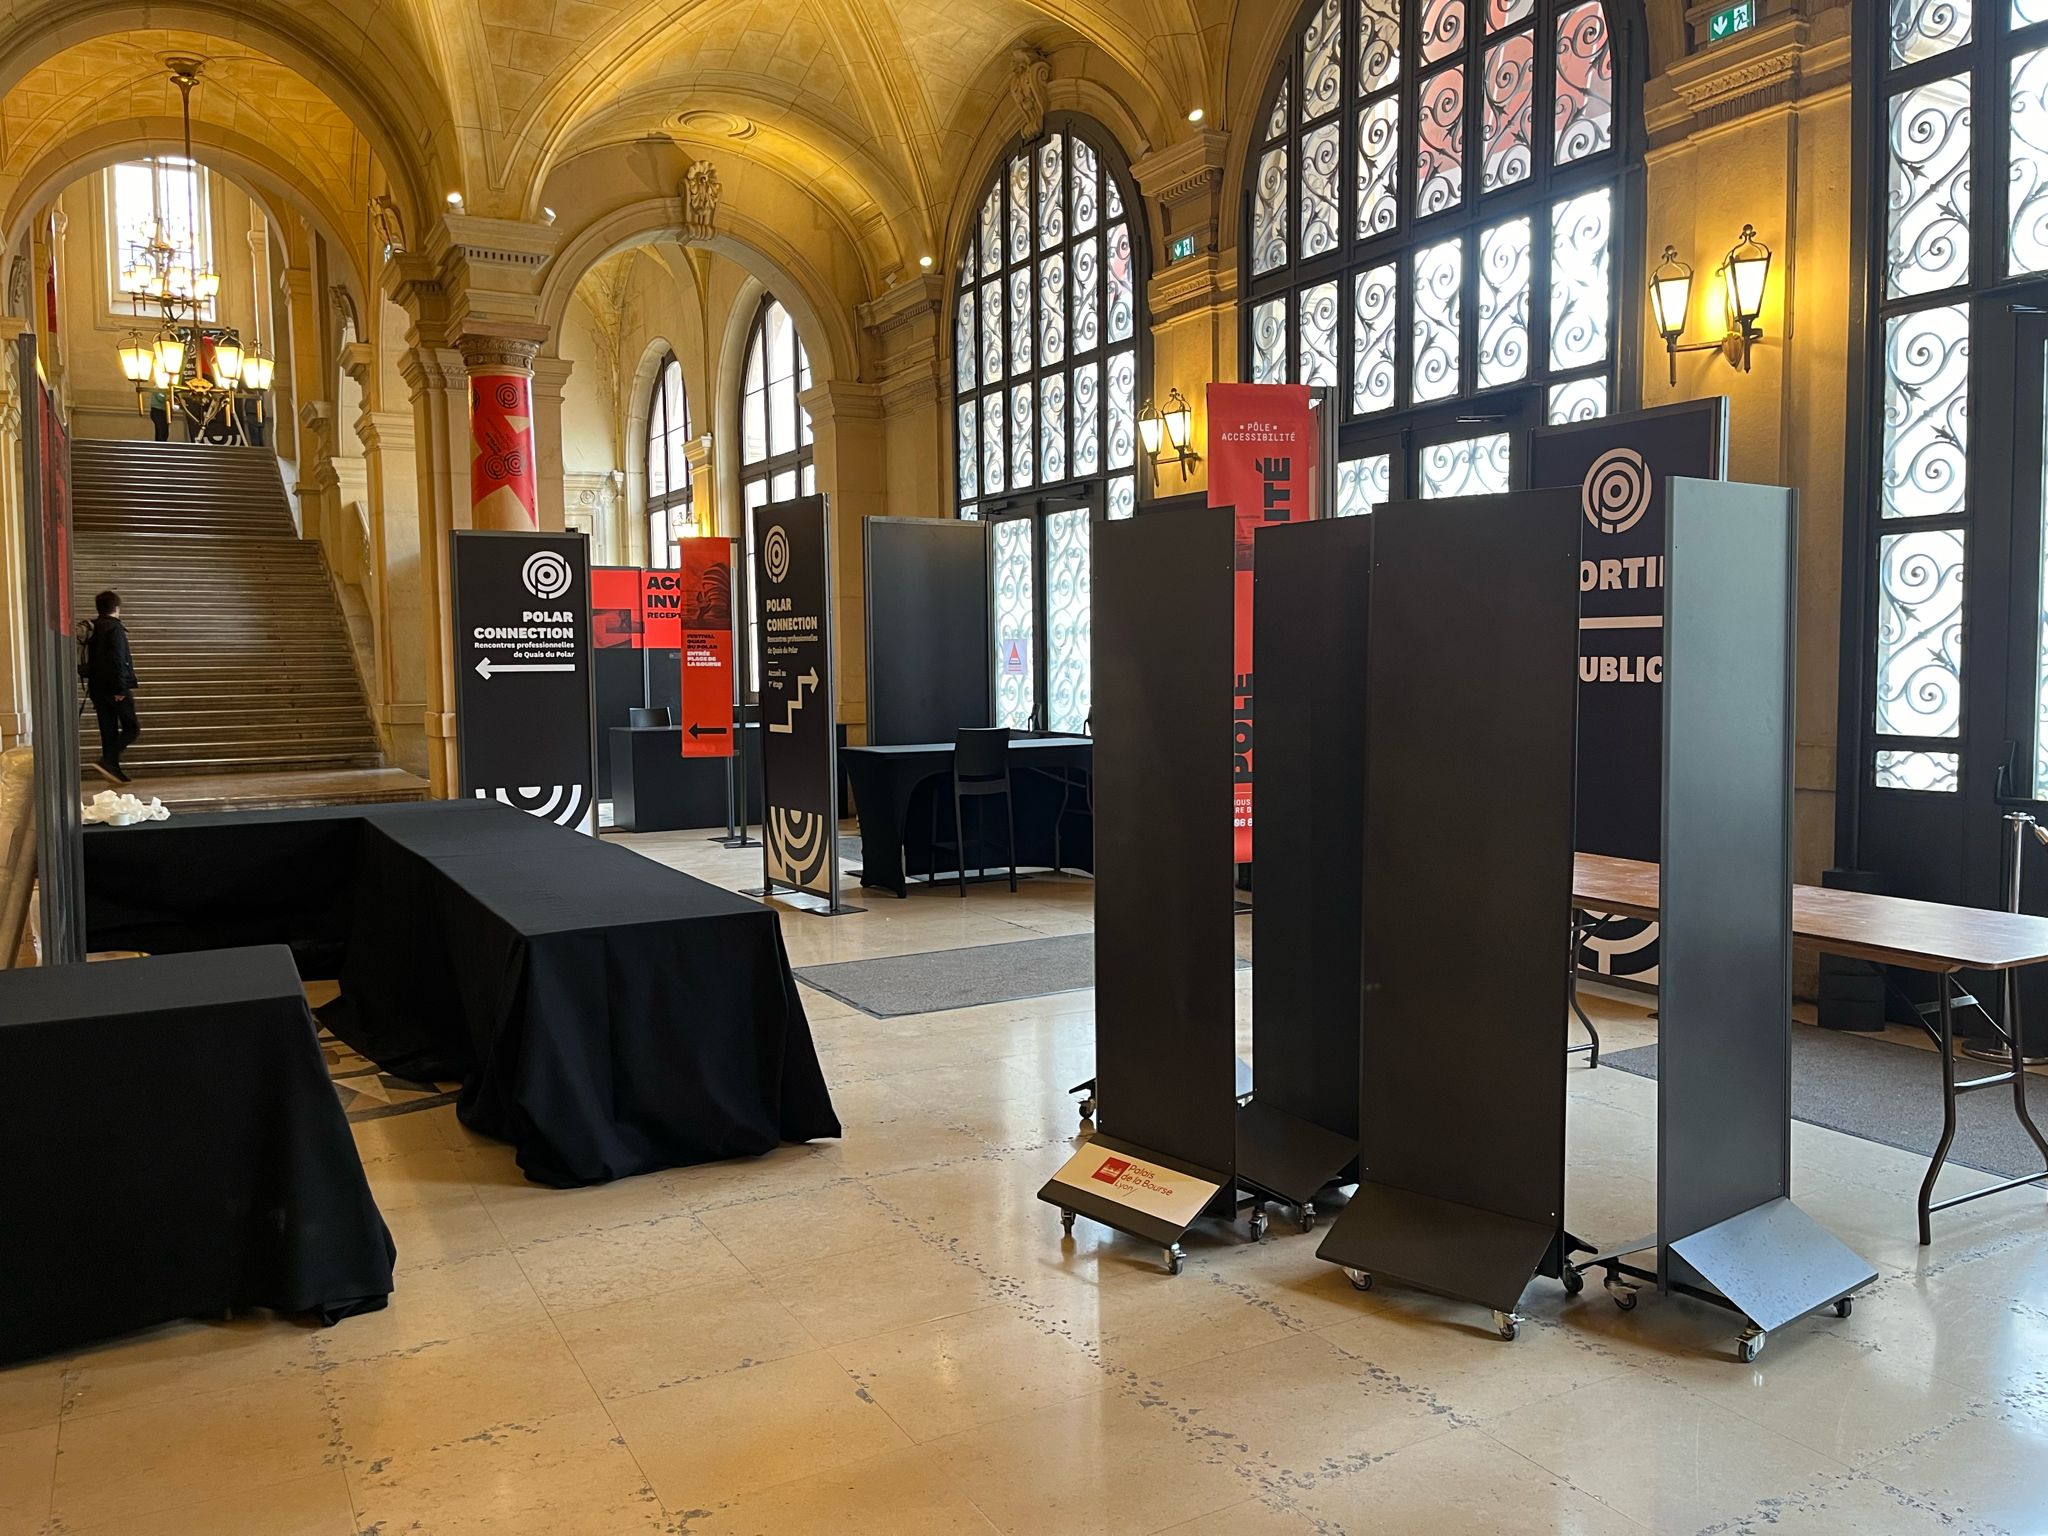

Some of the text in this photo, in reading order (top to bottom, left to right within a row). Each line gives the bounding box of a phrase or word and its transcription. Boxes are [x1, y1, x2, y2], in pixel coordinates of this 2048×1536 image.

[1248, 422, 1270, 431] PÔLE
[1222, 432, 1296, 441] ACCESSIBILITÉ
[1580, 556, 1663, 591] ORTI
[766, 598, 791, 612] POLAR
[523, 611, 574, 622] POLAR
[767, 616, 817, 632] CONNECTION
[474, 627, 574, 639] CONNECTION
[517, 641, 574, 649] professionnelles
[1579, 656, 1663, 682] UBLIC
[1128, 1164, 1155, 1179] Palais
[1114, 1181, 1134, 1191] Lyon
[1121, 1174, 1173, 1196] de la Bourse
